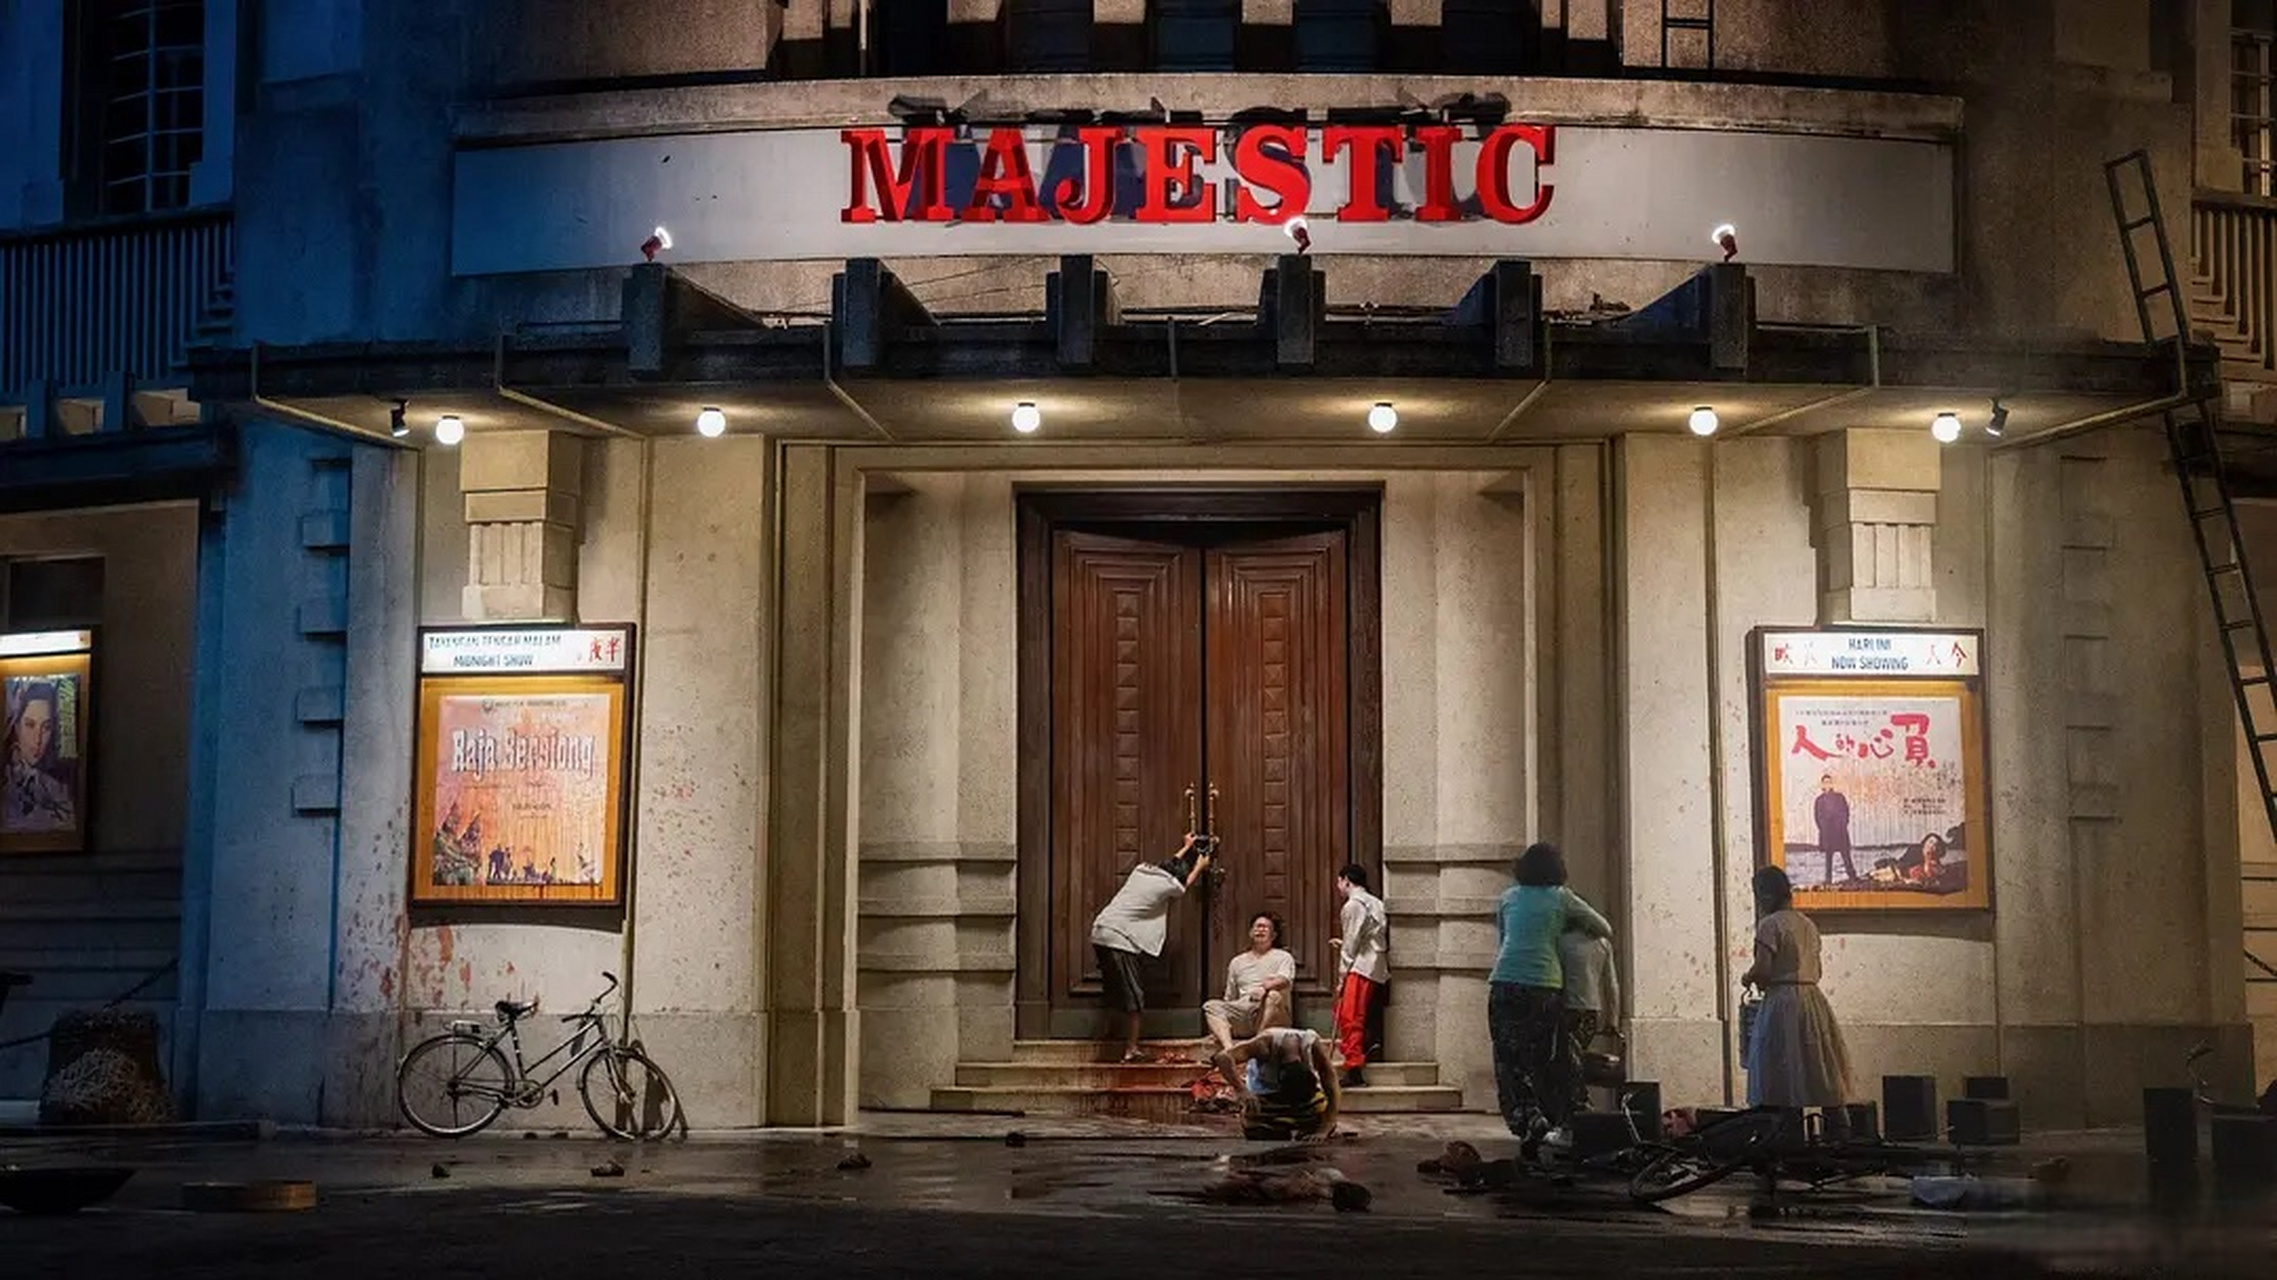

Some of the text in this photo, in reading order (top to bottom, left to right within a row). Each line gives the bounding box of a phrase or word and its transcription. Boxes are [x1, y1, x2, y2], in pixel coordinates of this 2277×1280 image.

[840, 123, 1556, 225] MAJESTIC
[453, 654, 535, 667] MIDNIGHT SHOW
[1832, 656, 1909, 670] NOW SHOWING
[452, 728, 498, 780] Raja
